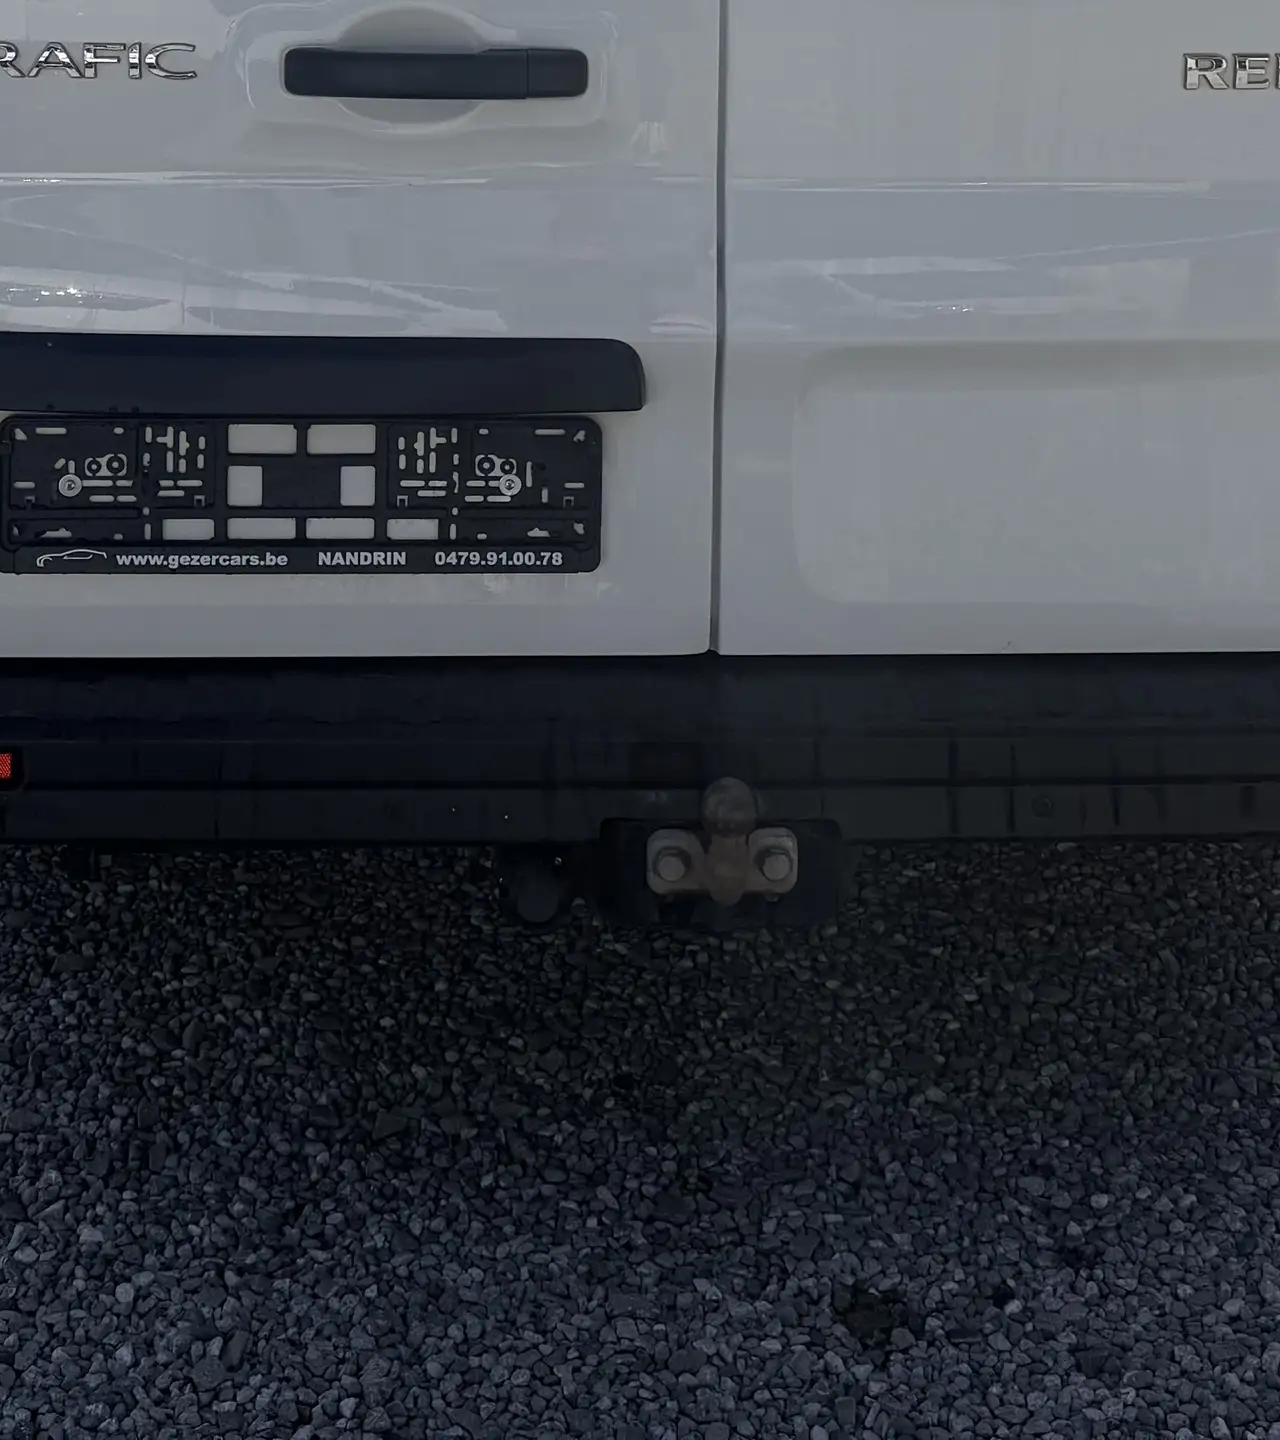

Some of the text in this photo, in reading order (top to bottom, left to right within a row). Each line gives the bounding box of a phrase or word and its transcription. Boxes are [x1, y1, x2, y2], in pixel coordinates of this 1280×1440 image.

[116, 551, 563, 568] www.gezercars.be NANDRIN 0479.91.00.78
